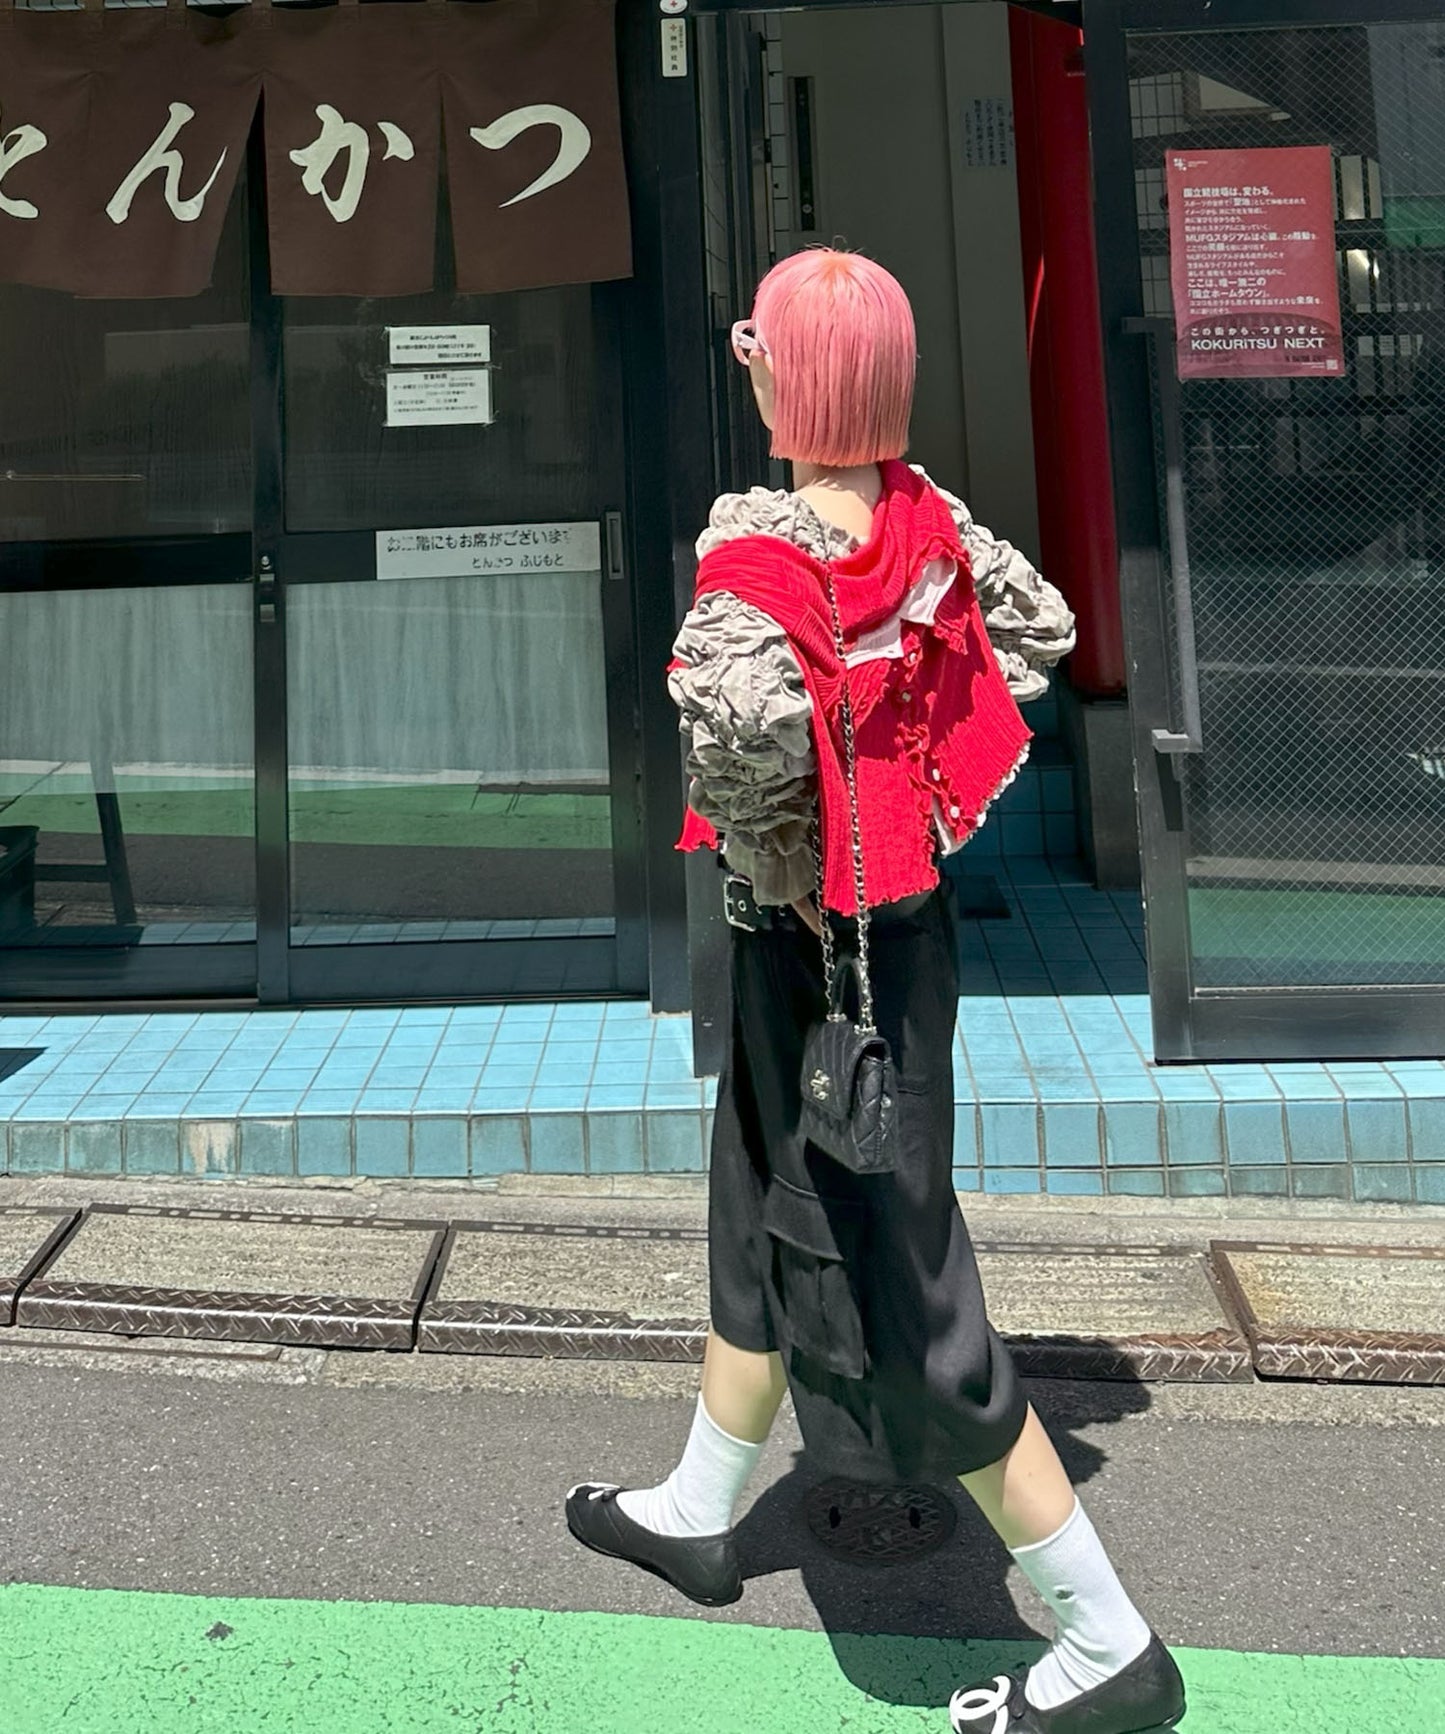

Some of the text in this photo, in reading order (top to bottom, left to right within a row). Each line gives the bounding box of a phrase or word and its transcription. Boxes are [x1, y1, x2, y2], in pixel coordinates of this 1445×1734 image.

[1284, 337, 1325, 349] NEXT
[520, 553, 564, 567] ふじもと
